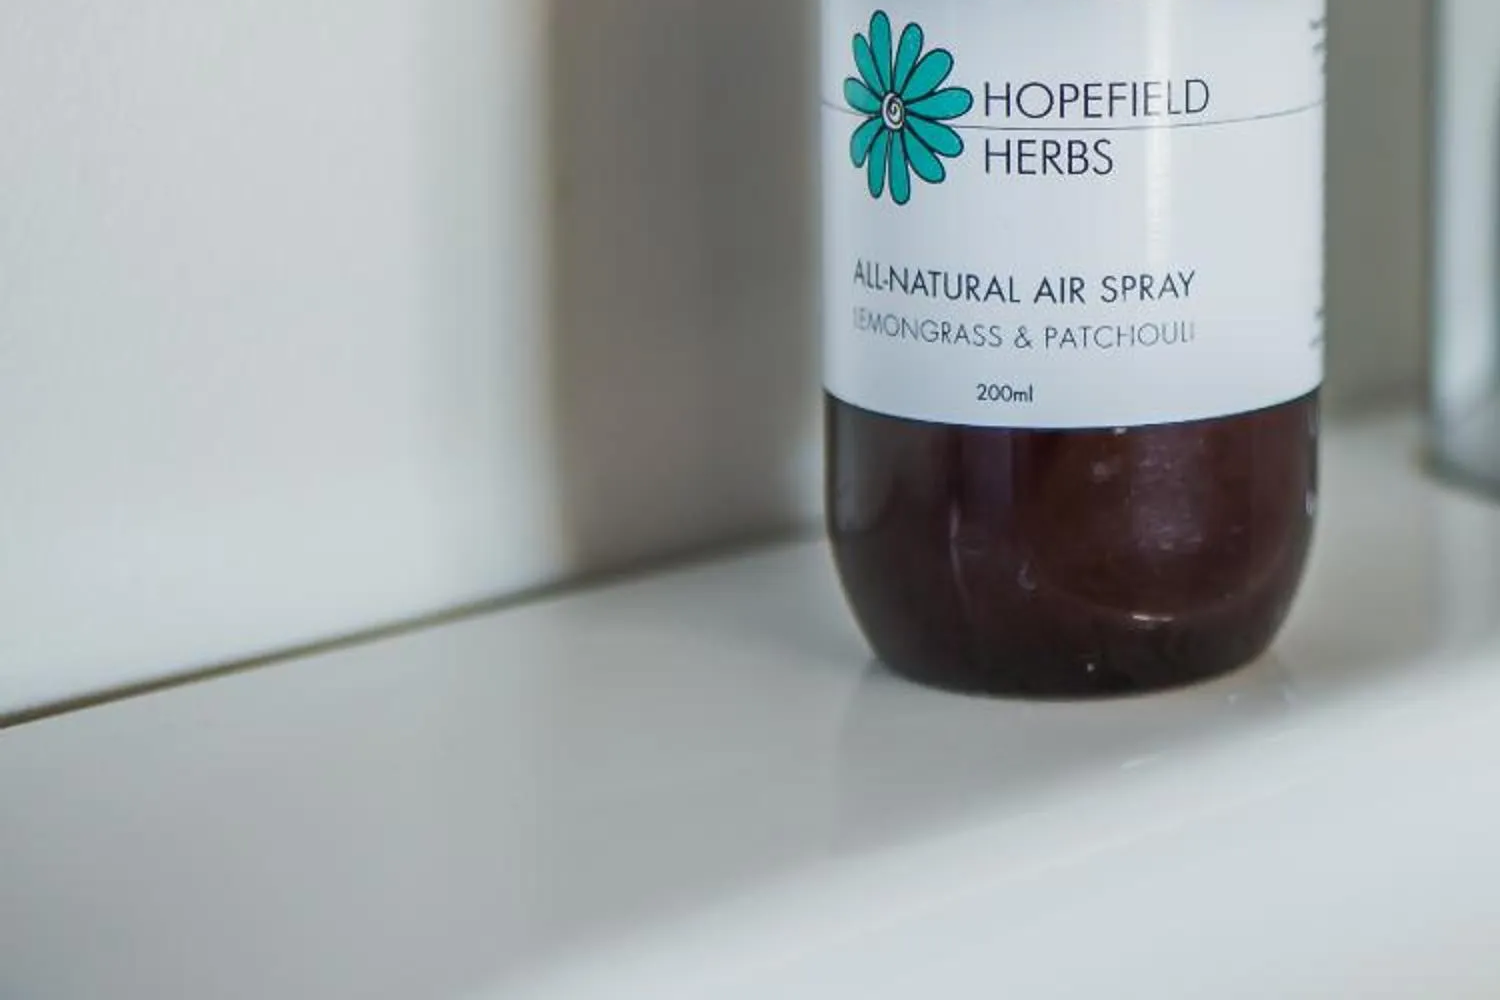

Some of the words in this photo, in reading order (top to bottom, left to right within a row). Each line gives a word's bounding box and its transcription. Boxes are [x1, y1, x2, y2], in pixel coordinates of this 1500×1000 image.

[984, 79, 1210, 119] HOPEFIELD
[984, 138, 1114, 175] HERBS
[853, 258, 1021, 304] ALL-NATURAL
[1033, 276, 1086, 304] AIR
[1100, 269, 1196, 303] SPRAY
[852, 305, 1003, 348] LEMONGRASS
[1014, 325, 1033, 349] &
[1044, 319, 1196, 350] PATCHOULI
[976, 383, 1033, 402] 200ml
